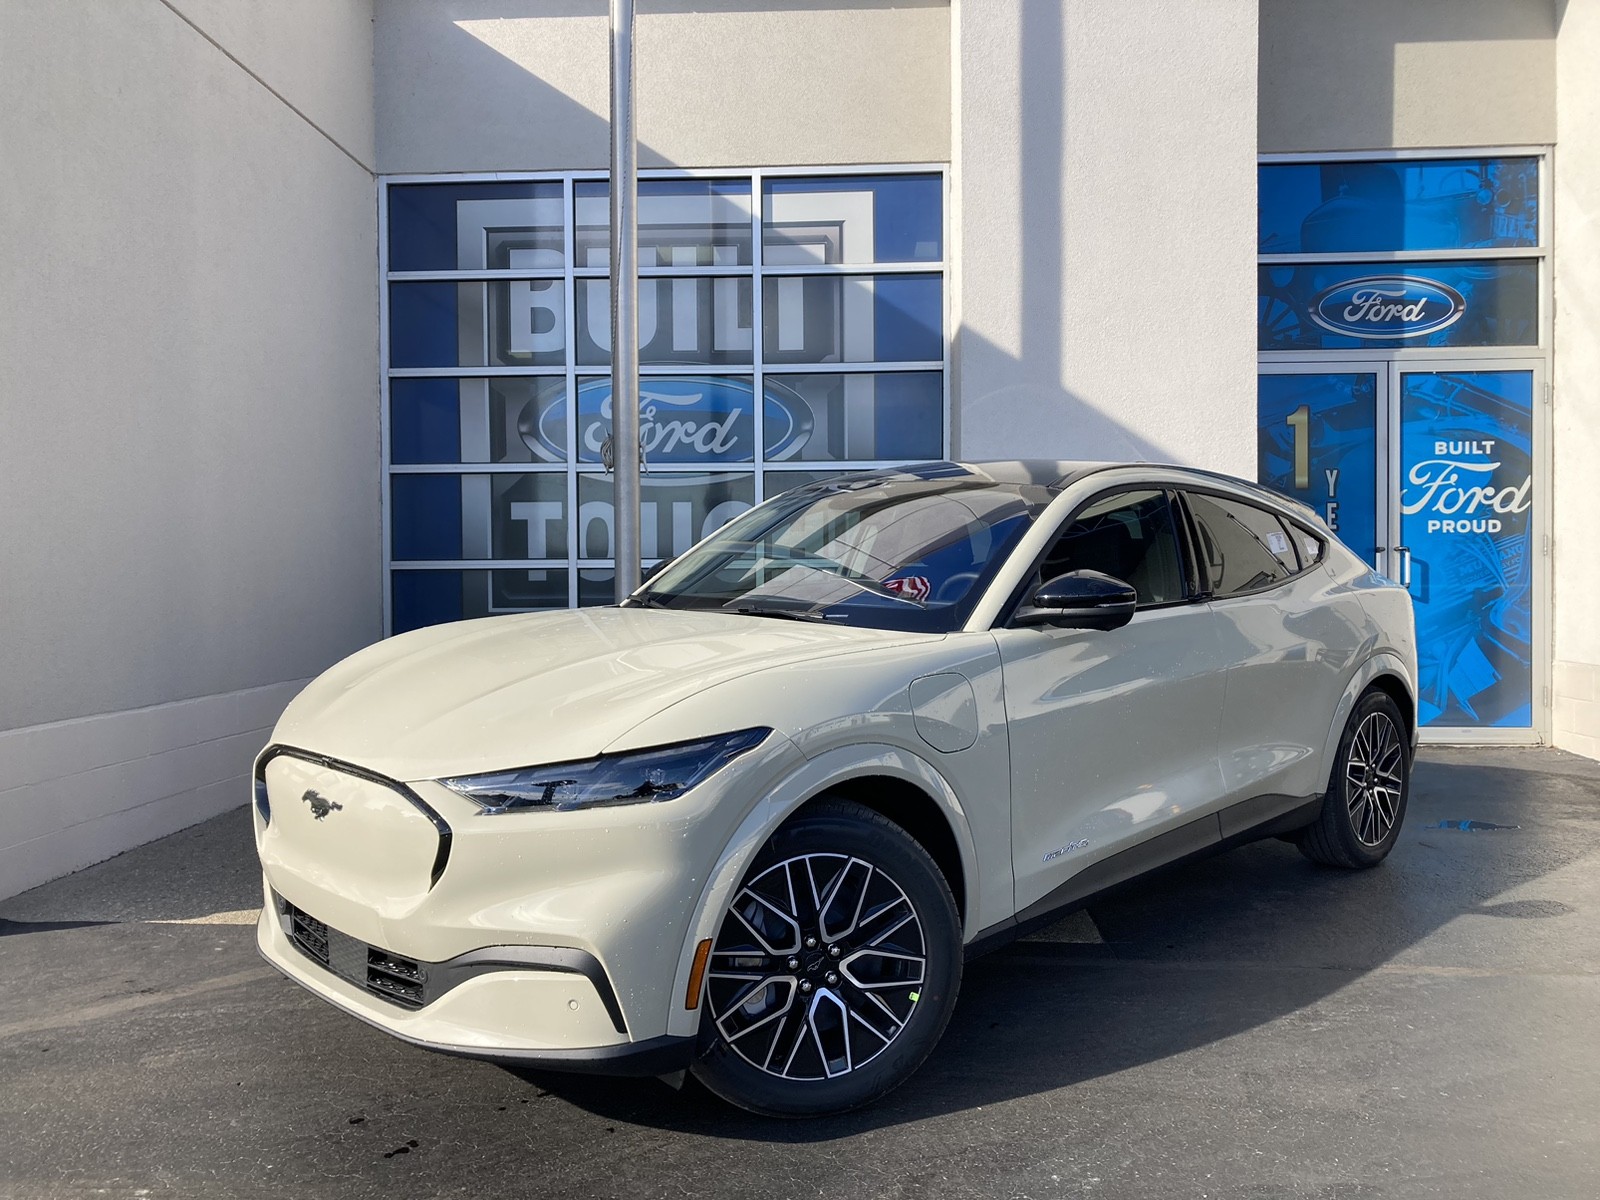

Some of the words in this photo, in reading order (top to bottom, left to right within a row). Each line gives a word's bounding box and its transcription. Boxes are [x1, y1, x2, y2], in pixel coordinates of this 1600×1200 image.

[510, 244, 826, 352] BUILT
[1343, 289, 1428, 322] Ford
[584, 390, 743, 454] Ford
[1286, 405, 1309, 489] 1
[1434, 441, 1495, 455] BUILT
[1400, 460, 1531, 515] Ford
[511, 500, 756, 582] TOU
[1427, 519, 1502, 534] PROUD
